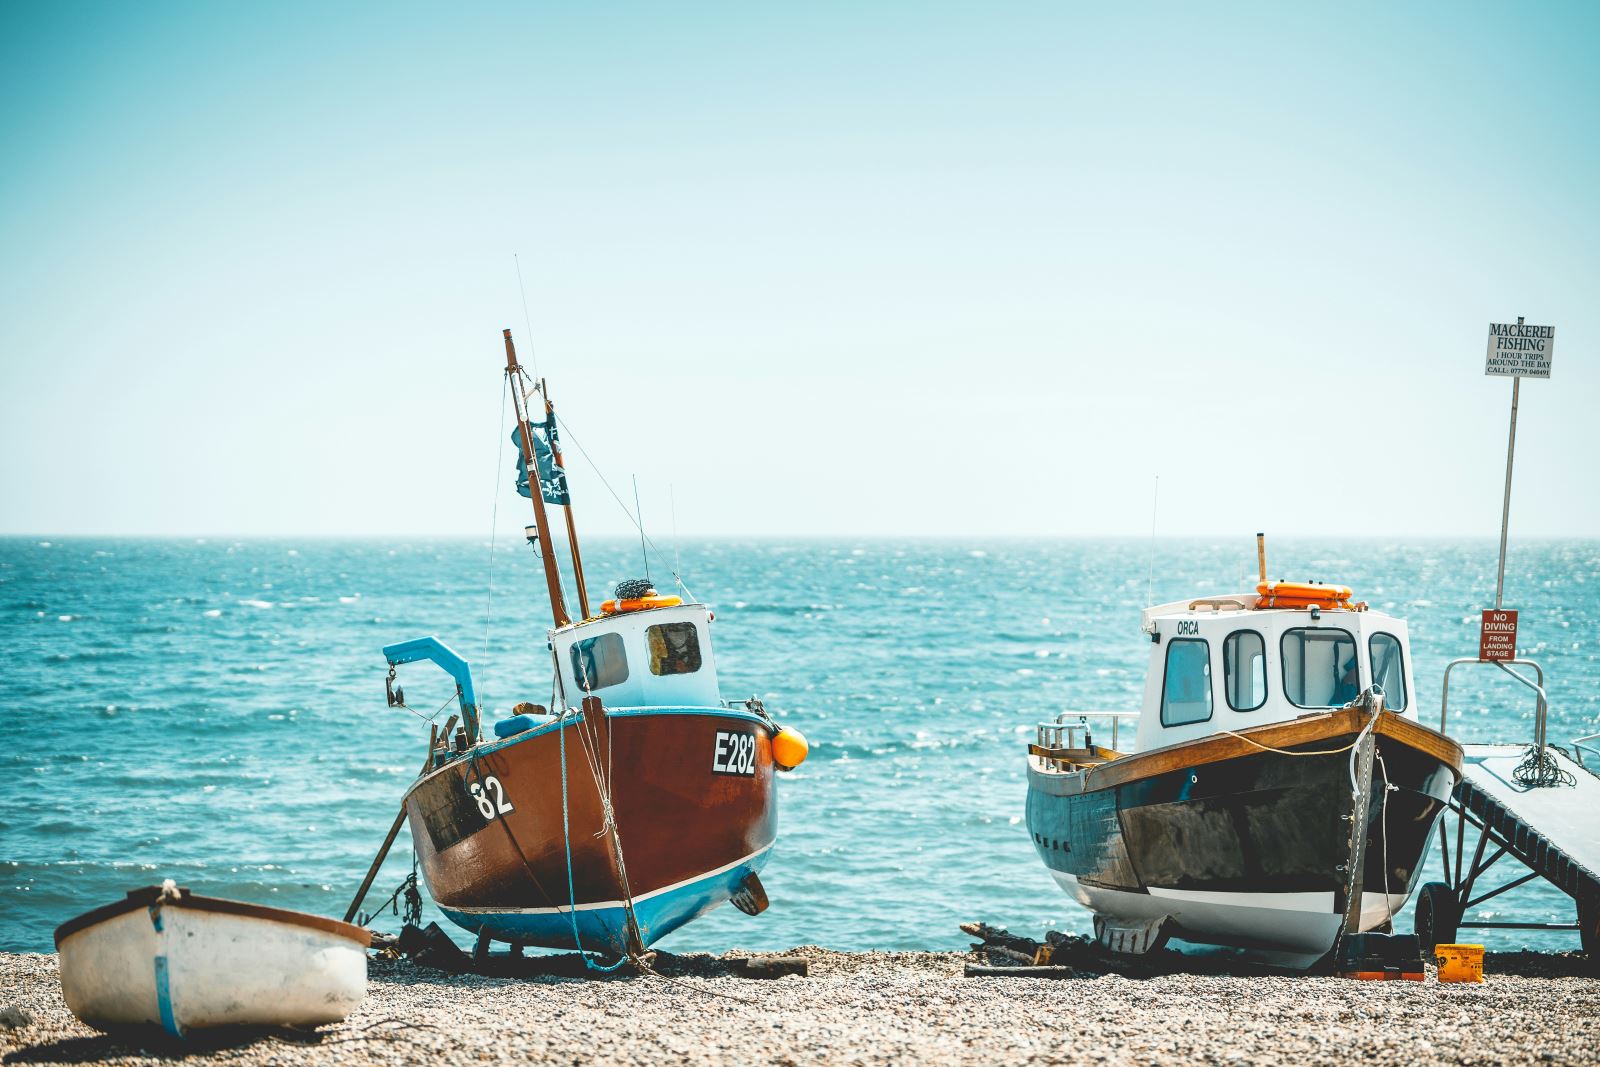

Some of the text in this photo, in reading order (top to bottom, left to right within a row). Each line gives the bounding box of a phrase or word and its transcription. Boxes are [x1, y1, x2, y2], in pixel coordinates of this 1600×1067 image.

[1490, 323, 1554, 339] MACKEREL
[1497, 337, 1545, 351] FISHING
[1501, 352, 1522, 360] HOUR
[1525, 353, 1544, 361] TRIPS
[1487, 358, 1519, 367] AROUND
[1521, 360, 1535, 368] THE
[1487, 366, 1509, 374] CALL:
[1493, 613, 1507, 622] NO
[1177, 620, 1199, 635] ORCA
[1484, 622, 1515, 631] DIVING
[713, 731, 756, 775] E282
[470, 776, 514, 820] 82
